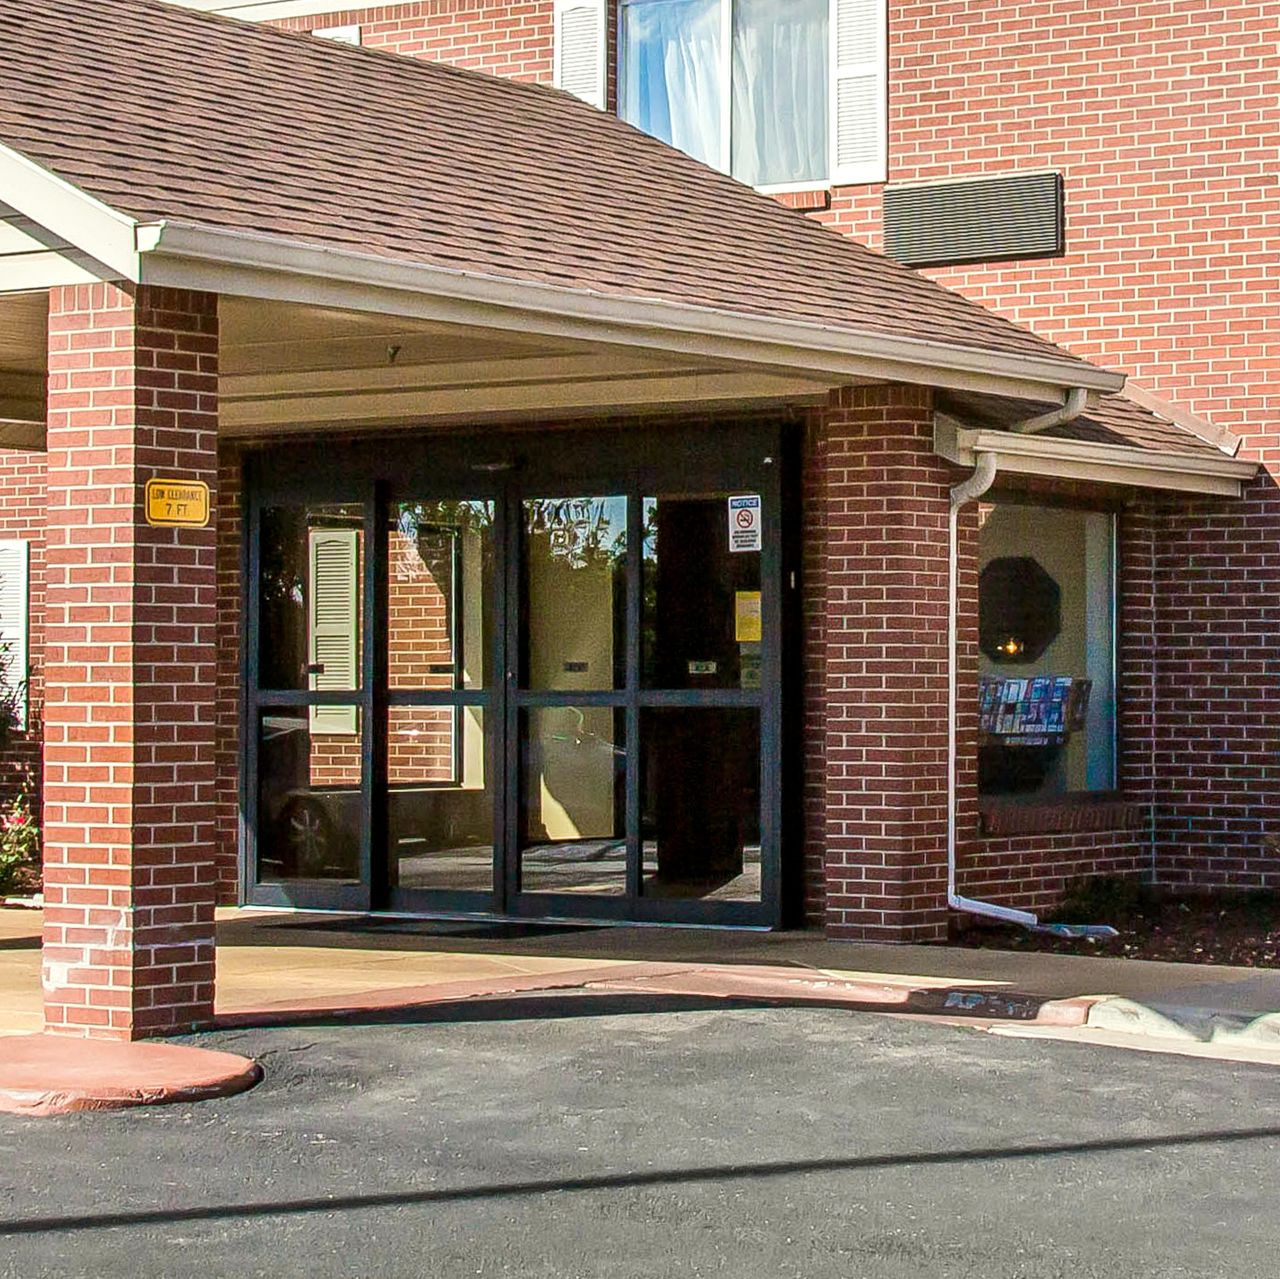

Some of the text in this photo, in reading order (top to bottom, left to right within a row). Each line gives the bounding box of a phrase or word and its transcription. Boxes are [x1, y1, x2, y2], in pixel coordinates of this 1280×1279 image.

[152, 488, 165, 500] LOW
[165, 503, 188, 515] 7 FT
